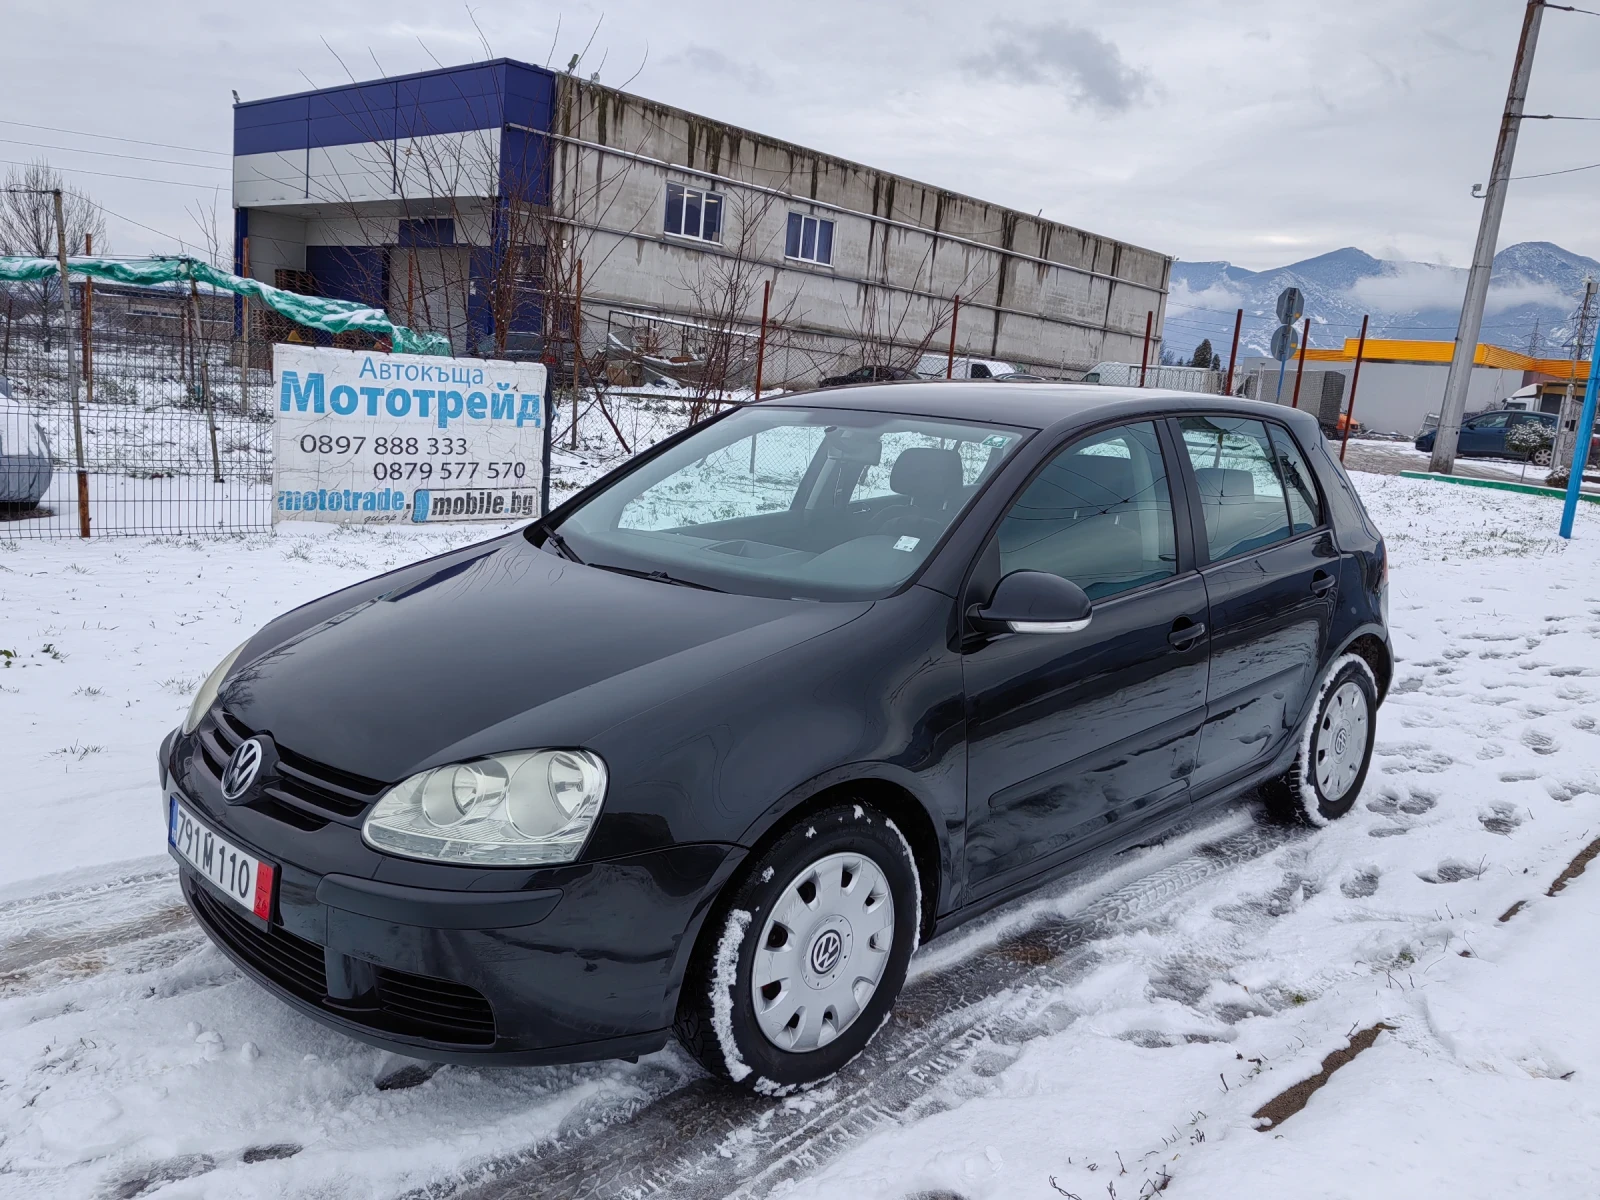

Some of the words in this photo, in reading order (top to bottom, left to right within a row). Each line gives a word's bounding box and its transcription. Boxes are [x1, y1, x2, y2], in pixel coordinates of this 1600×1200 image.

[358, 356, 484, 388] Автокъща
[280, 371, 541, 428] Мототрейд
[300, 434, 366, 455] 0897
[374, 437, 419, 456] 888
[426, 437, 468, 456] 333
[373, 462, 433, 481] 0879
[440, 462, 480, 480] 577
[487, 461, 526, 479] 570
[431, 491, 533, 515] mobile.bg
